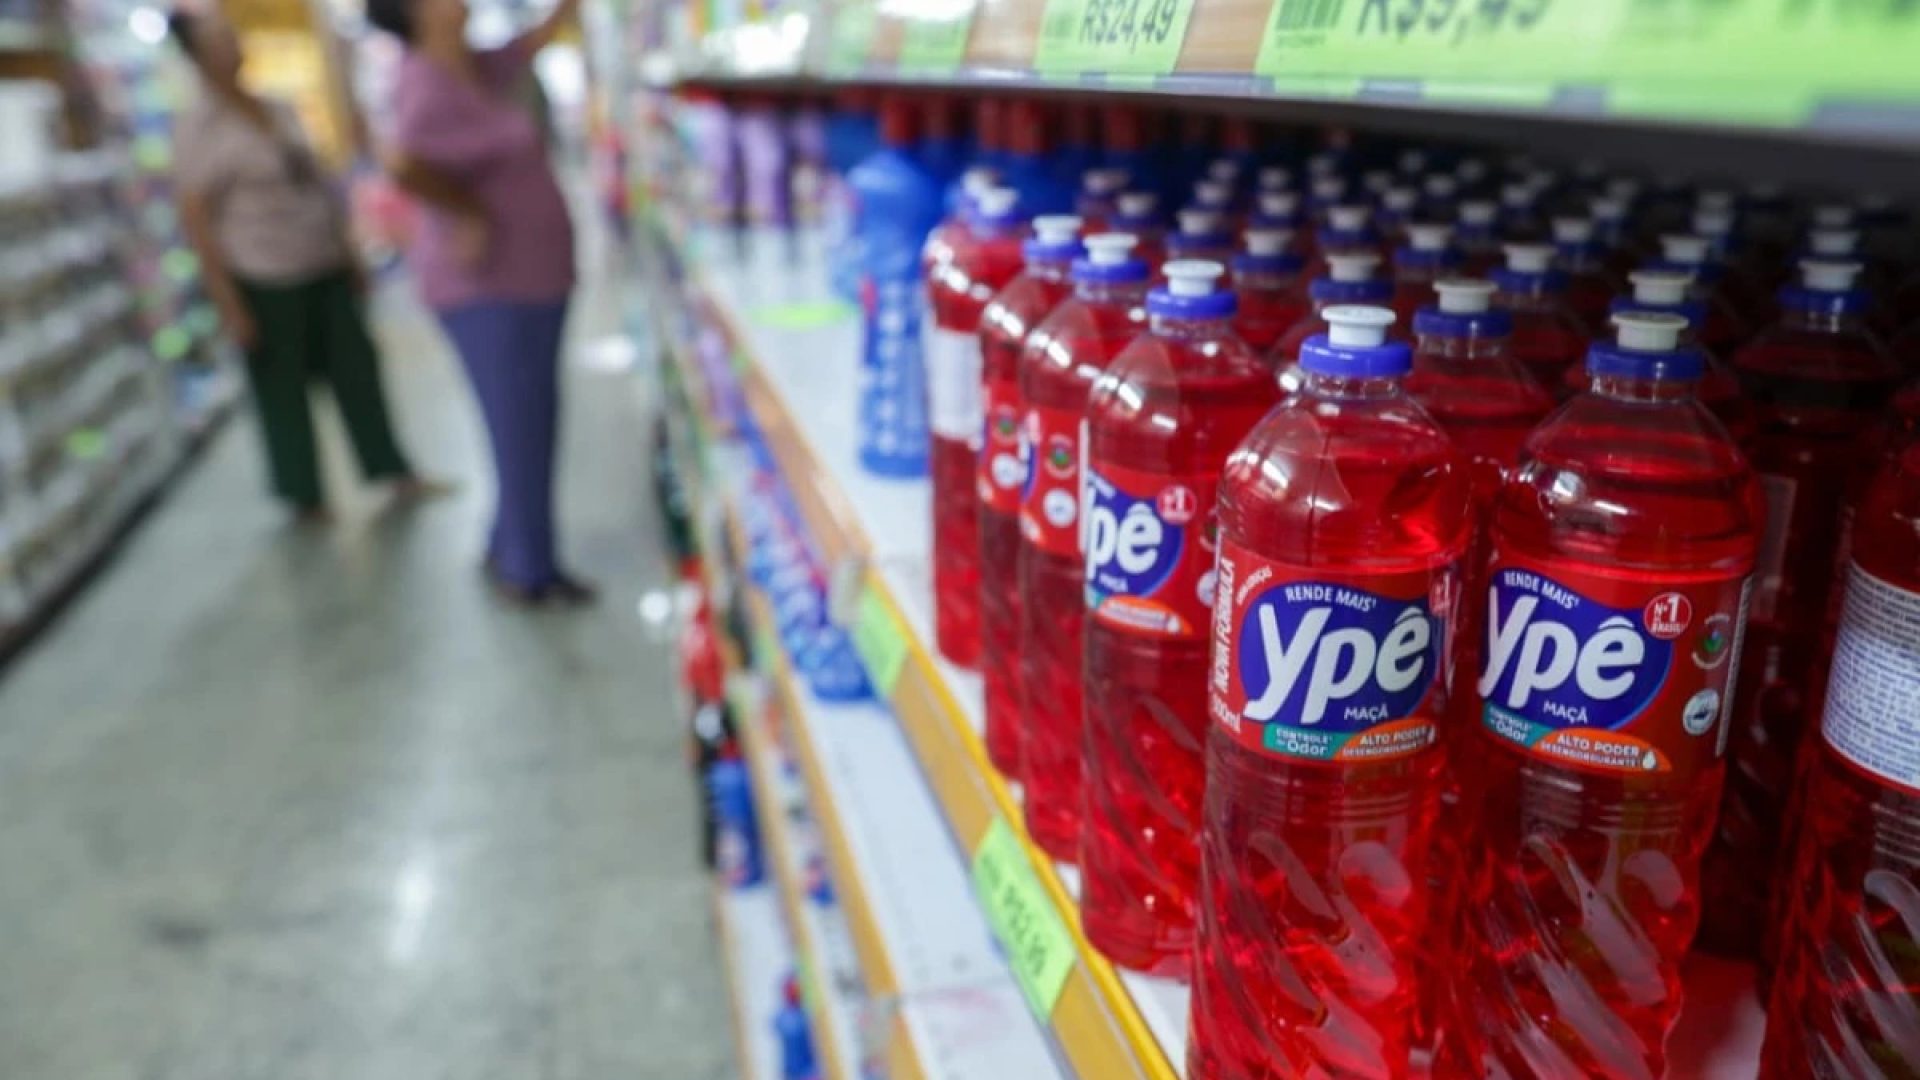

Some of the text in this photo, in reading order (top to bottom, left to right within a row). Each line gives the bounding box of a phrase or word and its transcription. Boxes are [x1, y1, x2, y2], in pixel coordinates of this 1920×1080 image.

[1285, 586, 1333, 603] RENDE
[1477, 585, 1645, 709] Ypê
[1243, 603, 1430, 724] Ypê
[1343, 704, 1388, 723] MAÇÃ
[1543, 700, 1588, 724] MAÇÃ
[1287, 738, 1328, 756] Odor
[1360, 733, 1390, 746] ALTO
[1557, 733, 1640, 757] ALTO PODER
